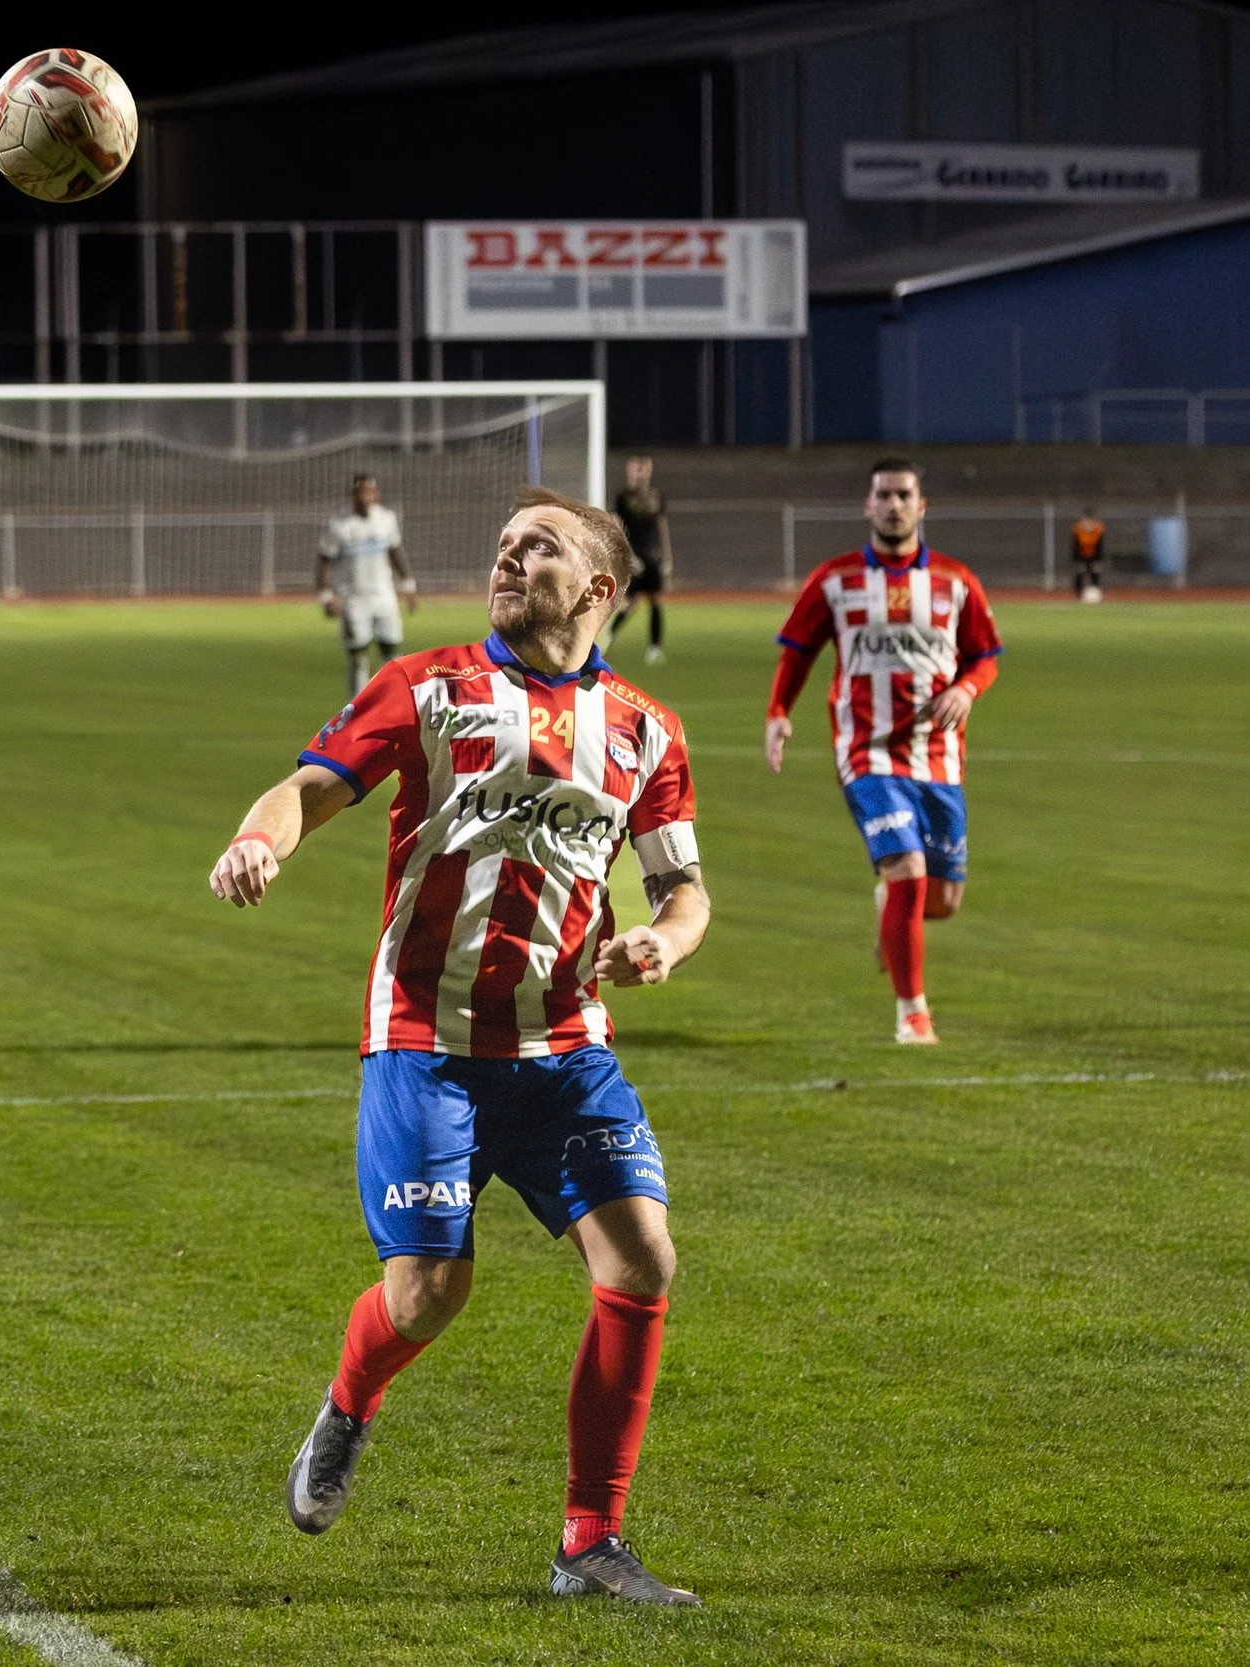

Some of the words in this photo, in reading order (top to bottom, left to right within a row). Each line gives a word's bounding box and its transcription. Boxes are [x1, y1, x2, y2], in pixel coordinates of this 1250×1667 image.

[610, 680, 666, 724] TEXWAX
[530, 706, 574, 749] 24
[456, 778, 614, 846] fusion
